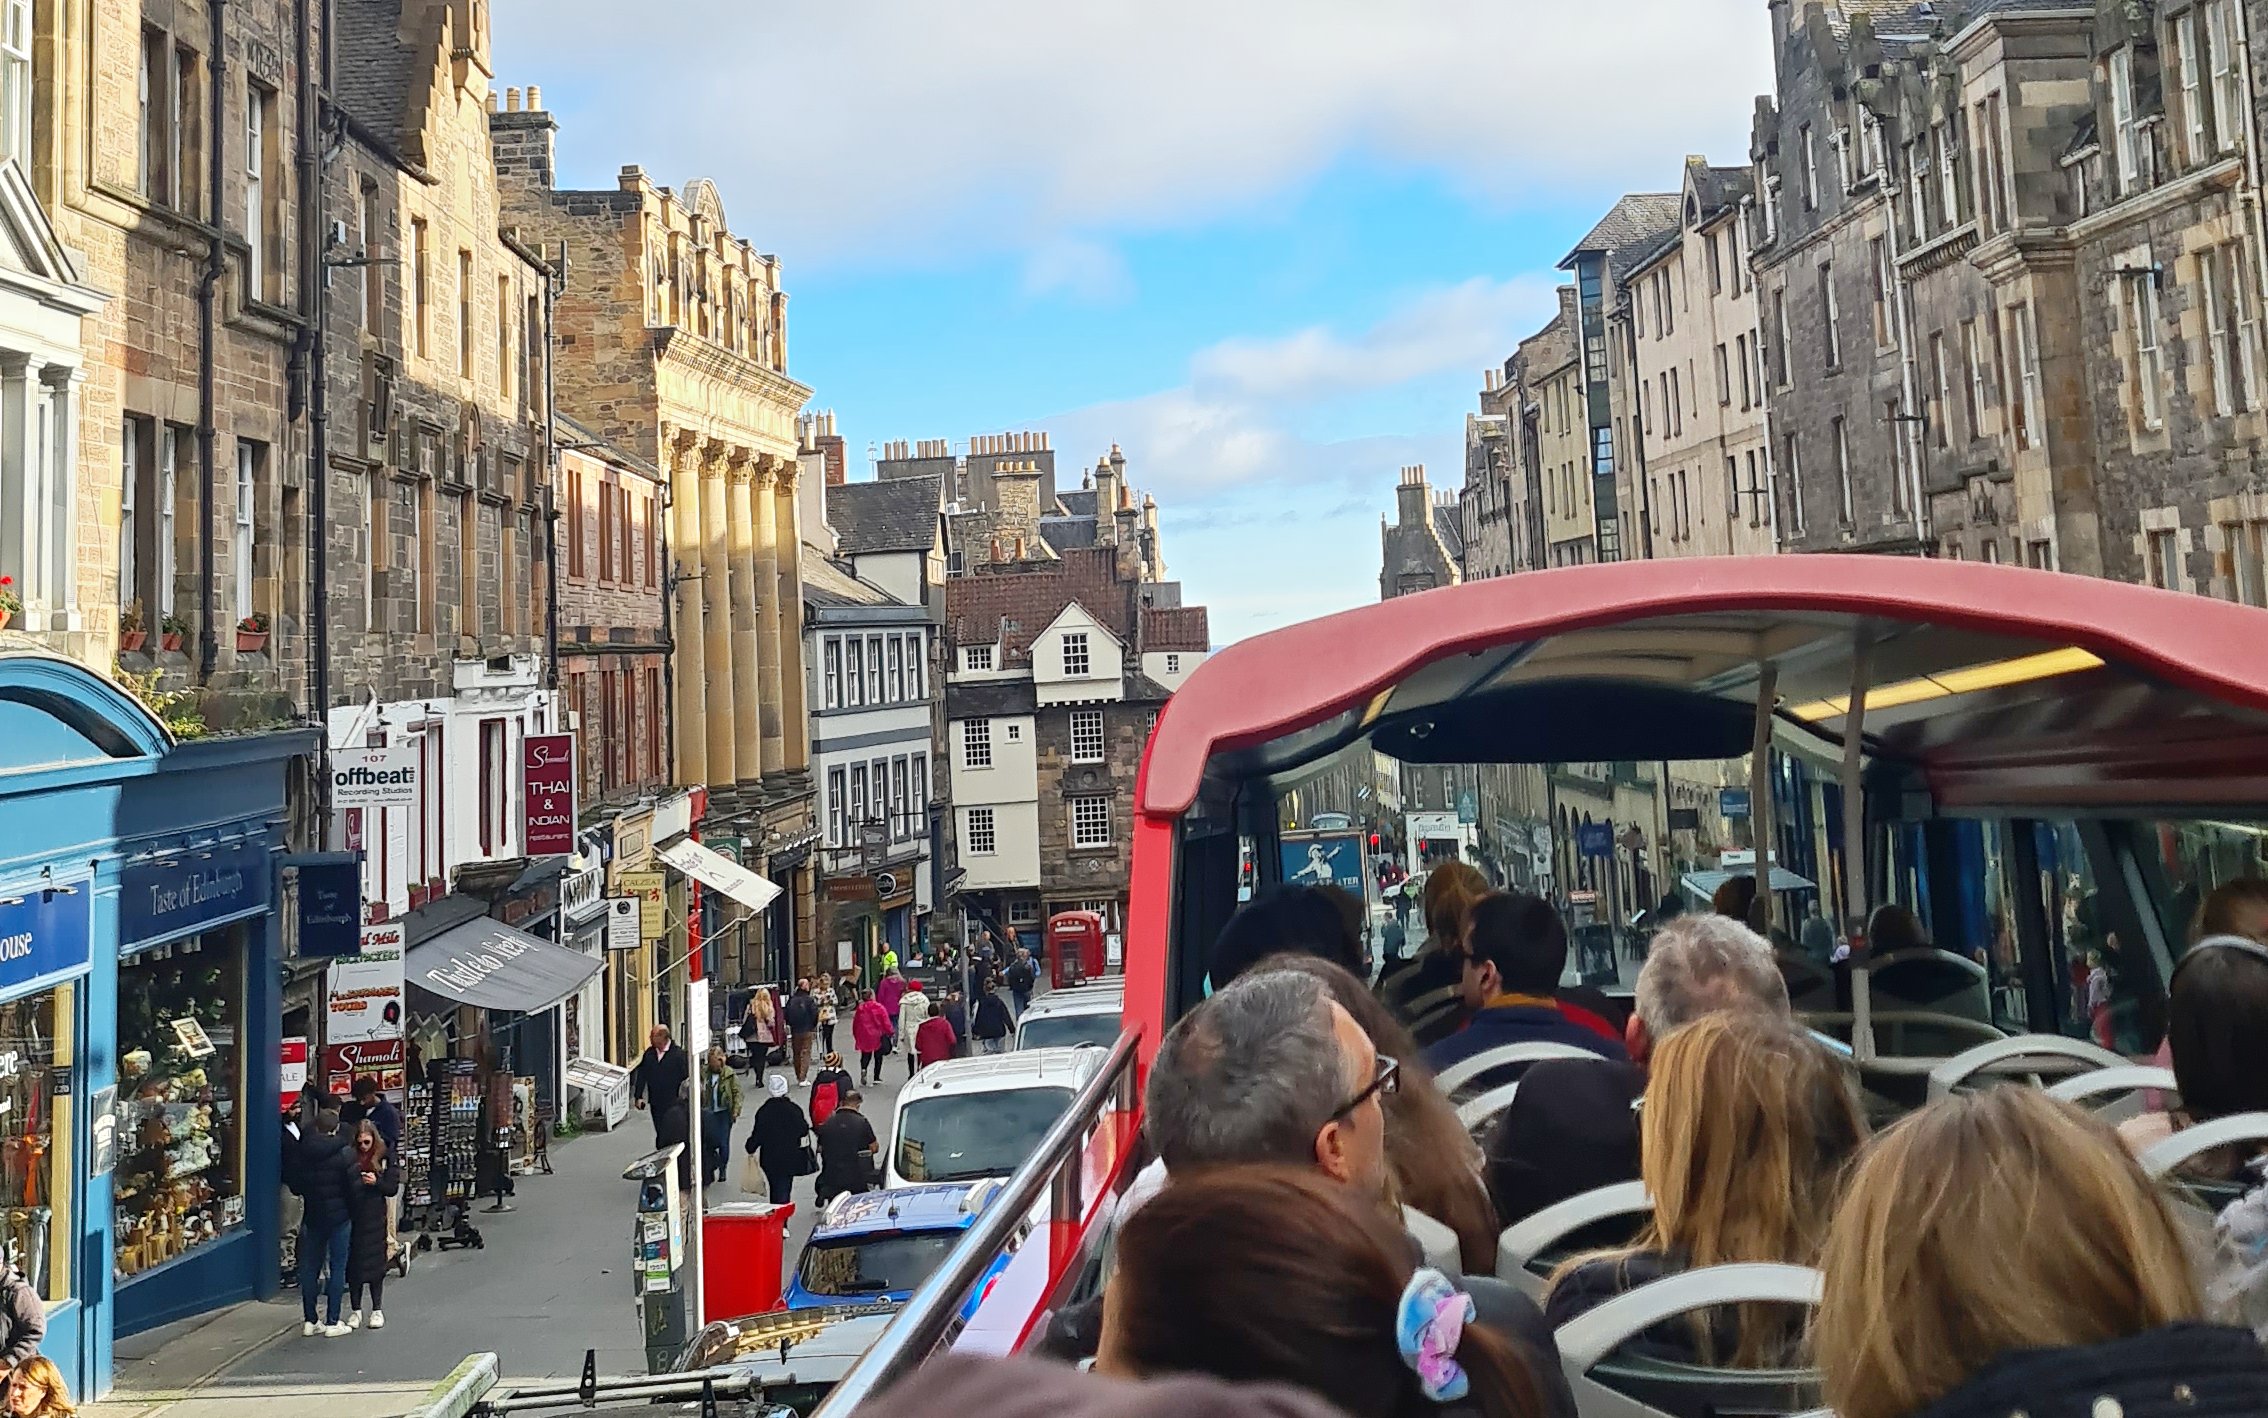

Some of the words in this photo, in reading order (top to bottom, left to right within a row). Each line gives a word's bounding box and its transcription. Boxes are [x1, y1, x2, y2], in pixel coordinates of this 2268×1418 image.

[335, 767, 411, 786] offbeat
[337, 788, 379, 796] Recording
[382, 787, 413, 795] Studios
[528, 780, 569, 795] THAI
[543, 799, 554, 810] &
[528, 814, 570, 826] INDIAN
[150, 884, 177, 916] Taste
[180, 874, 191, 909] of
[192, 868, 243, 904] Edinburgh
[372, 930, 400, 946] Mile
[330, 1041, 400, 1073] Shamoli
